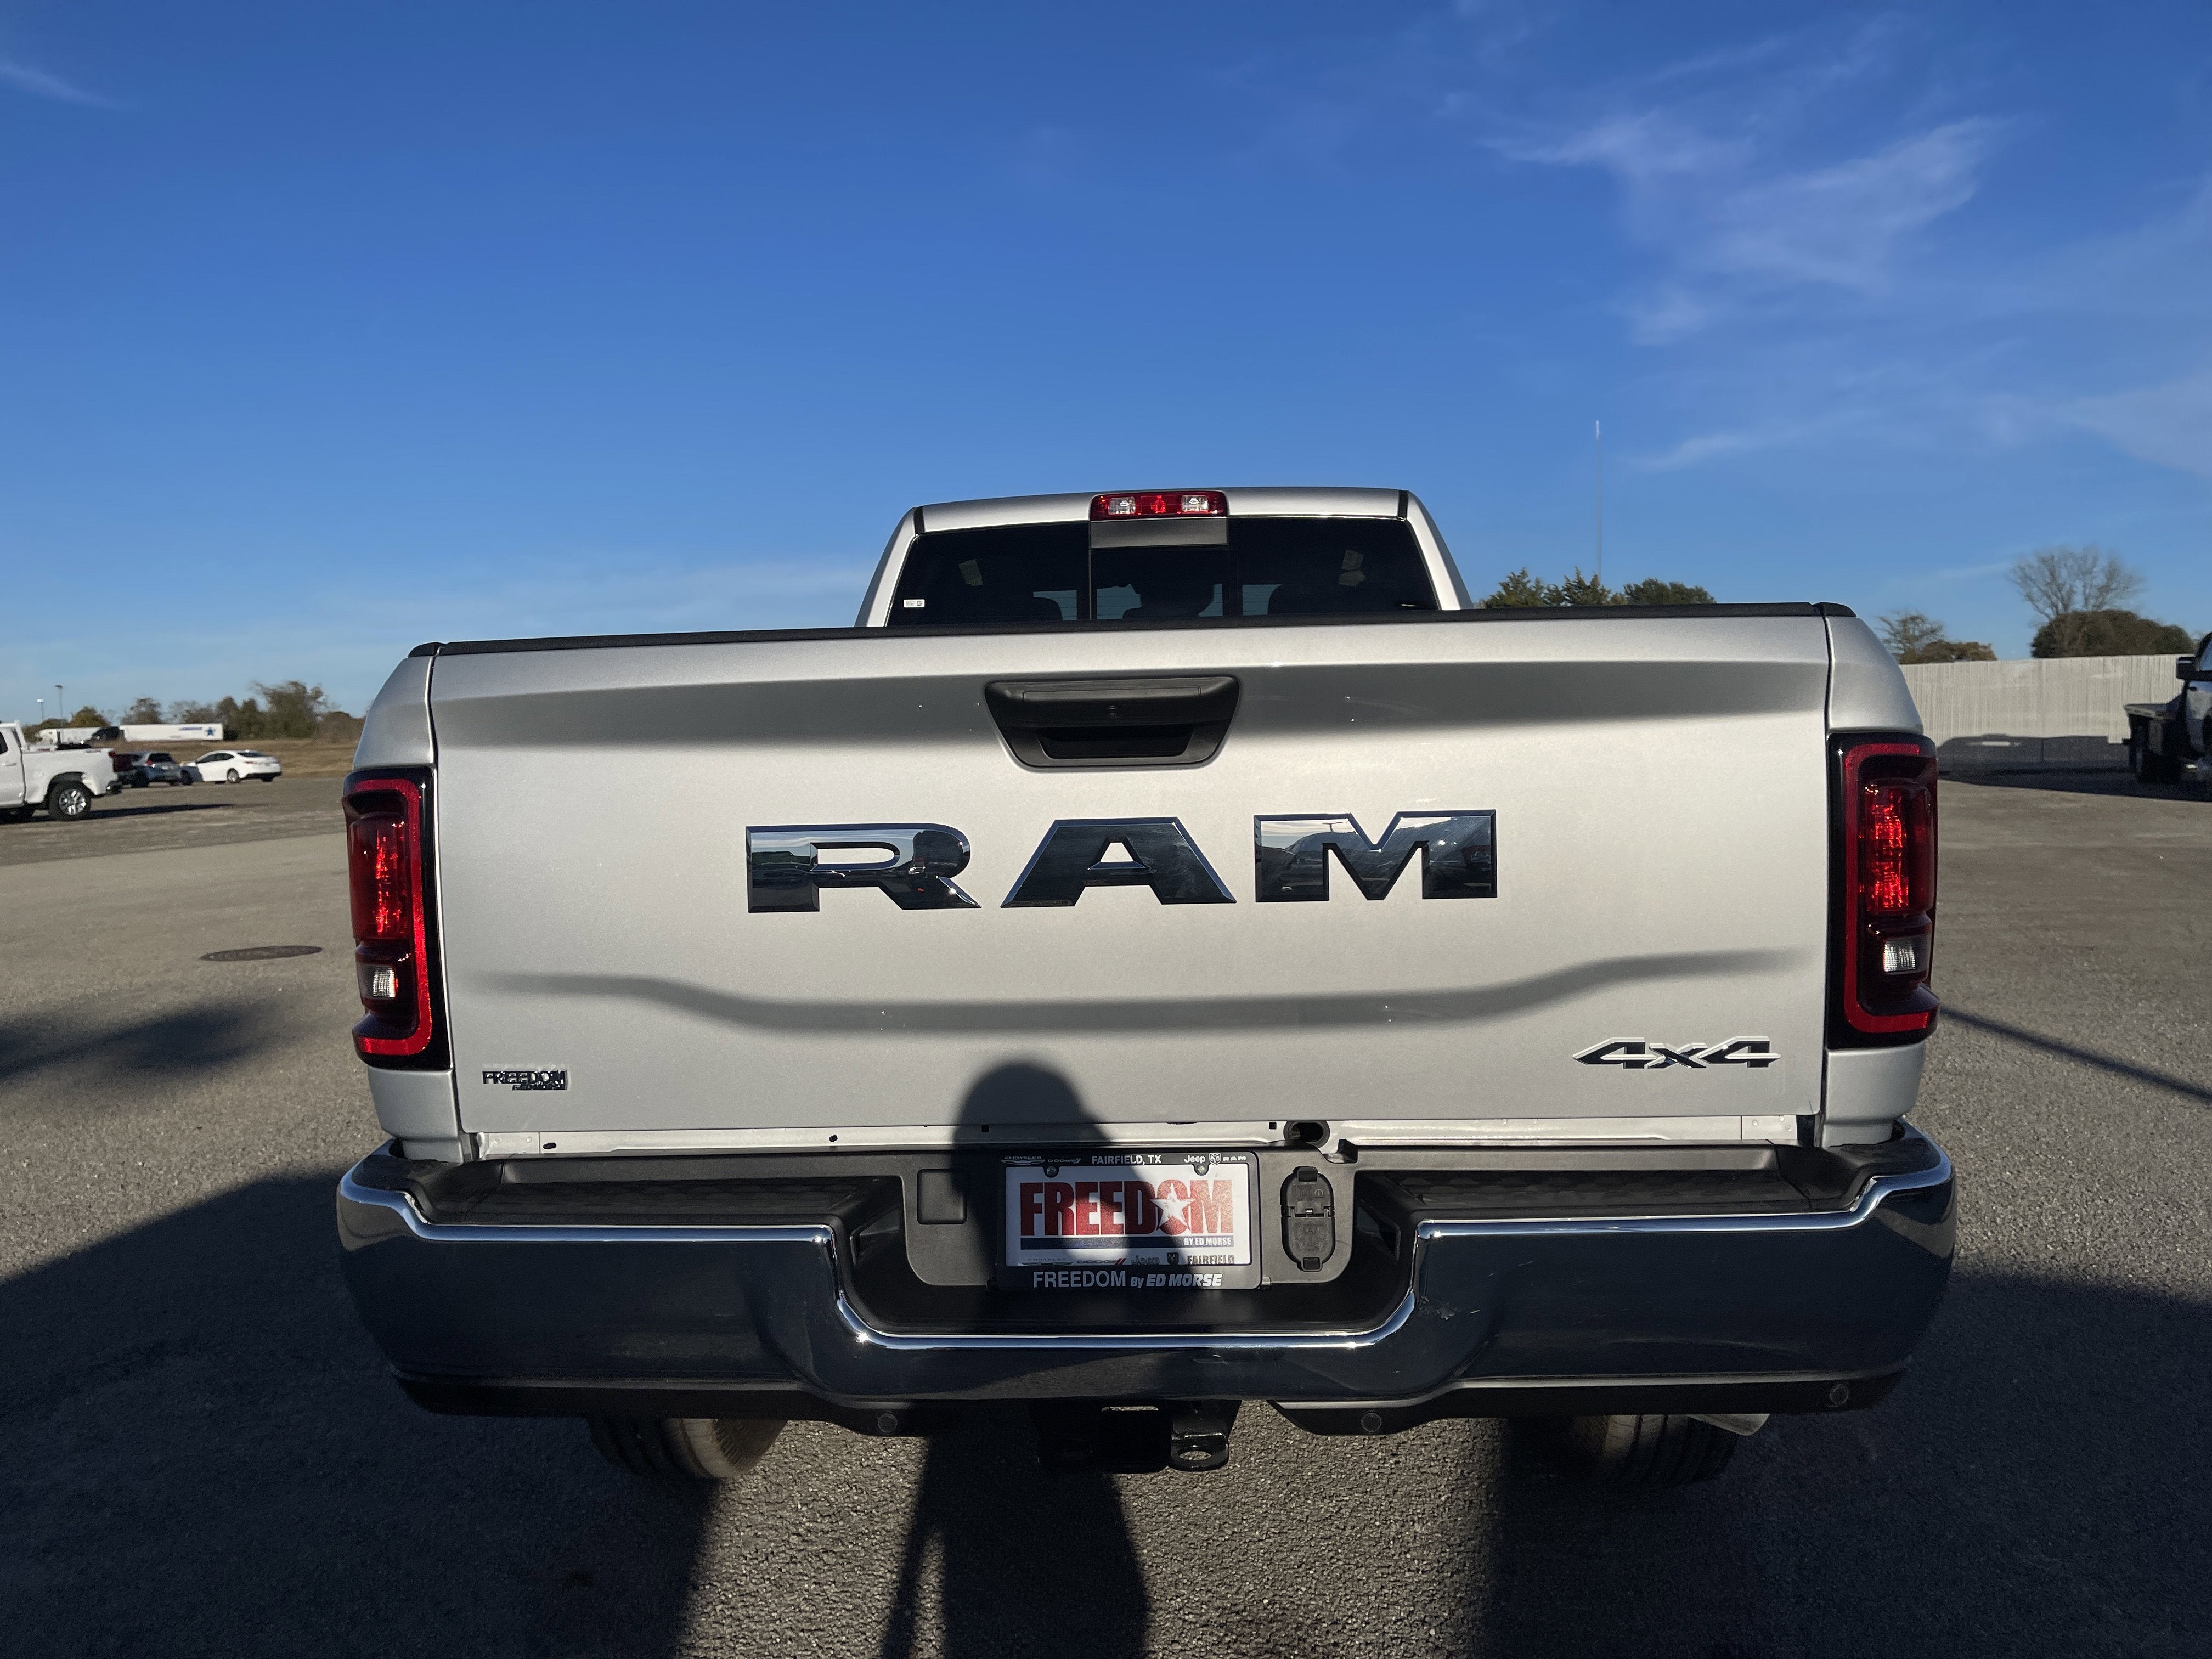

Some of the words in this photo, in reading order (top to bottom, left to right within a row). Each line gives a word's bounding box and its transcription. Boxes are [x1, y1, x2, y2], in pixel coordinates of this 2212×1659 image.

[745, 809, 1498, 913] RAM
[482, 1070, 567, 1085] FREEDOM
[1091, 1155, 1145, 1165] FAIRFIELD,
[1147, 1154, 1162, 1164] TX
[1184, 1155, 1206, 1164] Jeep
[1020, 1179, 1234, 1236] FREEDOM
[1184, 1238, 1193, 1246] BY
[1206, 1237, 1232, 1245] MORSE
[1187, 1255, 1235, 1265] FAIRFIELD
[1033, 1270, 1126, 1288] FREEDOM
[1130, 1277, 1144, 1289] By
[1146, 1274, 1166, 1287] ED
[1168, 1273, 1223, 1287] MORSE
